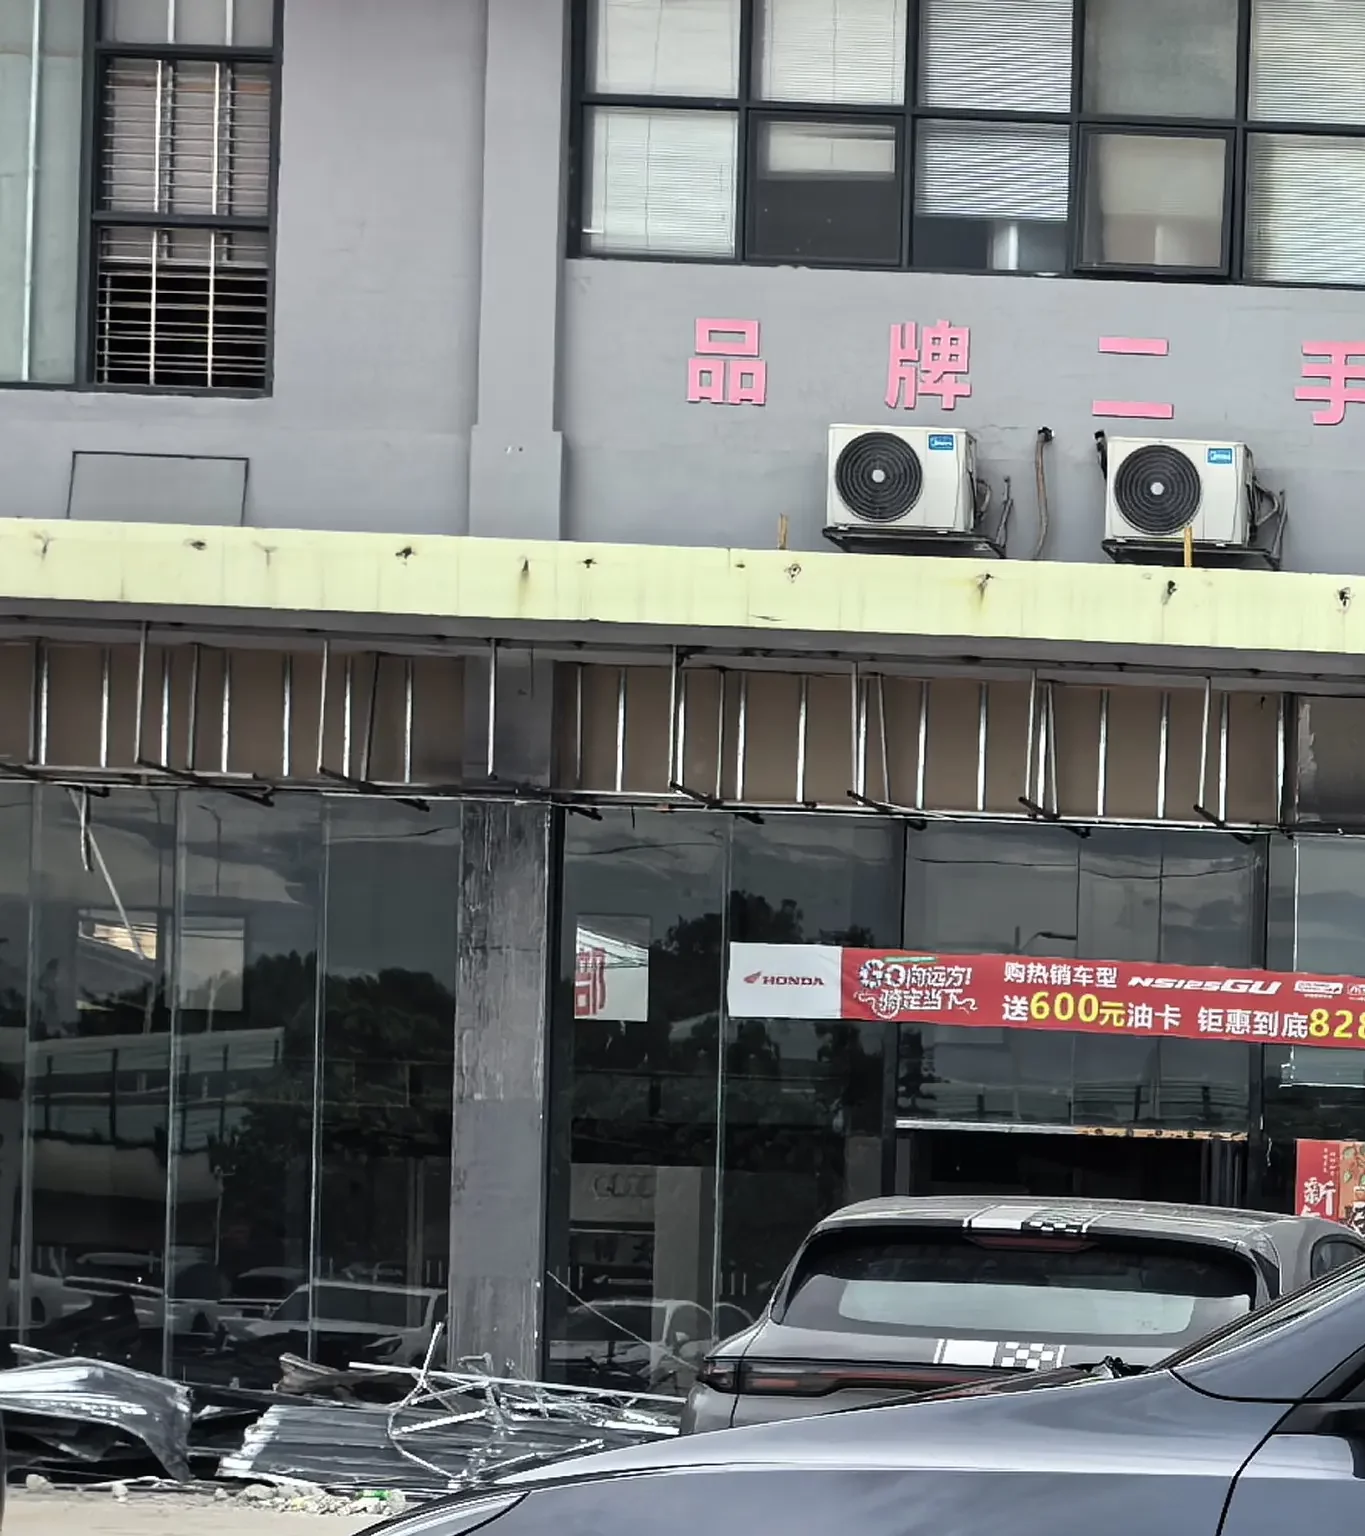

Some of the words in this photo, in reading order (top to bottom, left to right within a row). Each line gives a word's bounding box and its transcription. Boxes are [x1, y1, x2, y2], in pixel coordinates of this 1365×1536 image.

[762, 975, 825, 986] HONDA
[1003, 961, 1119, 989] 购热销车型
[1002, 991, 1182, 1030] 送600元油卡
